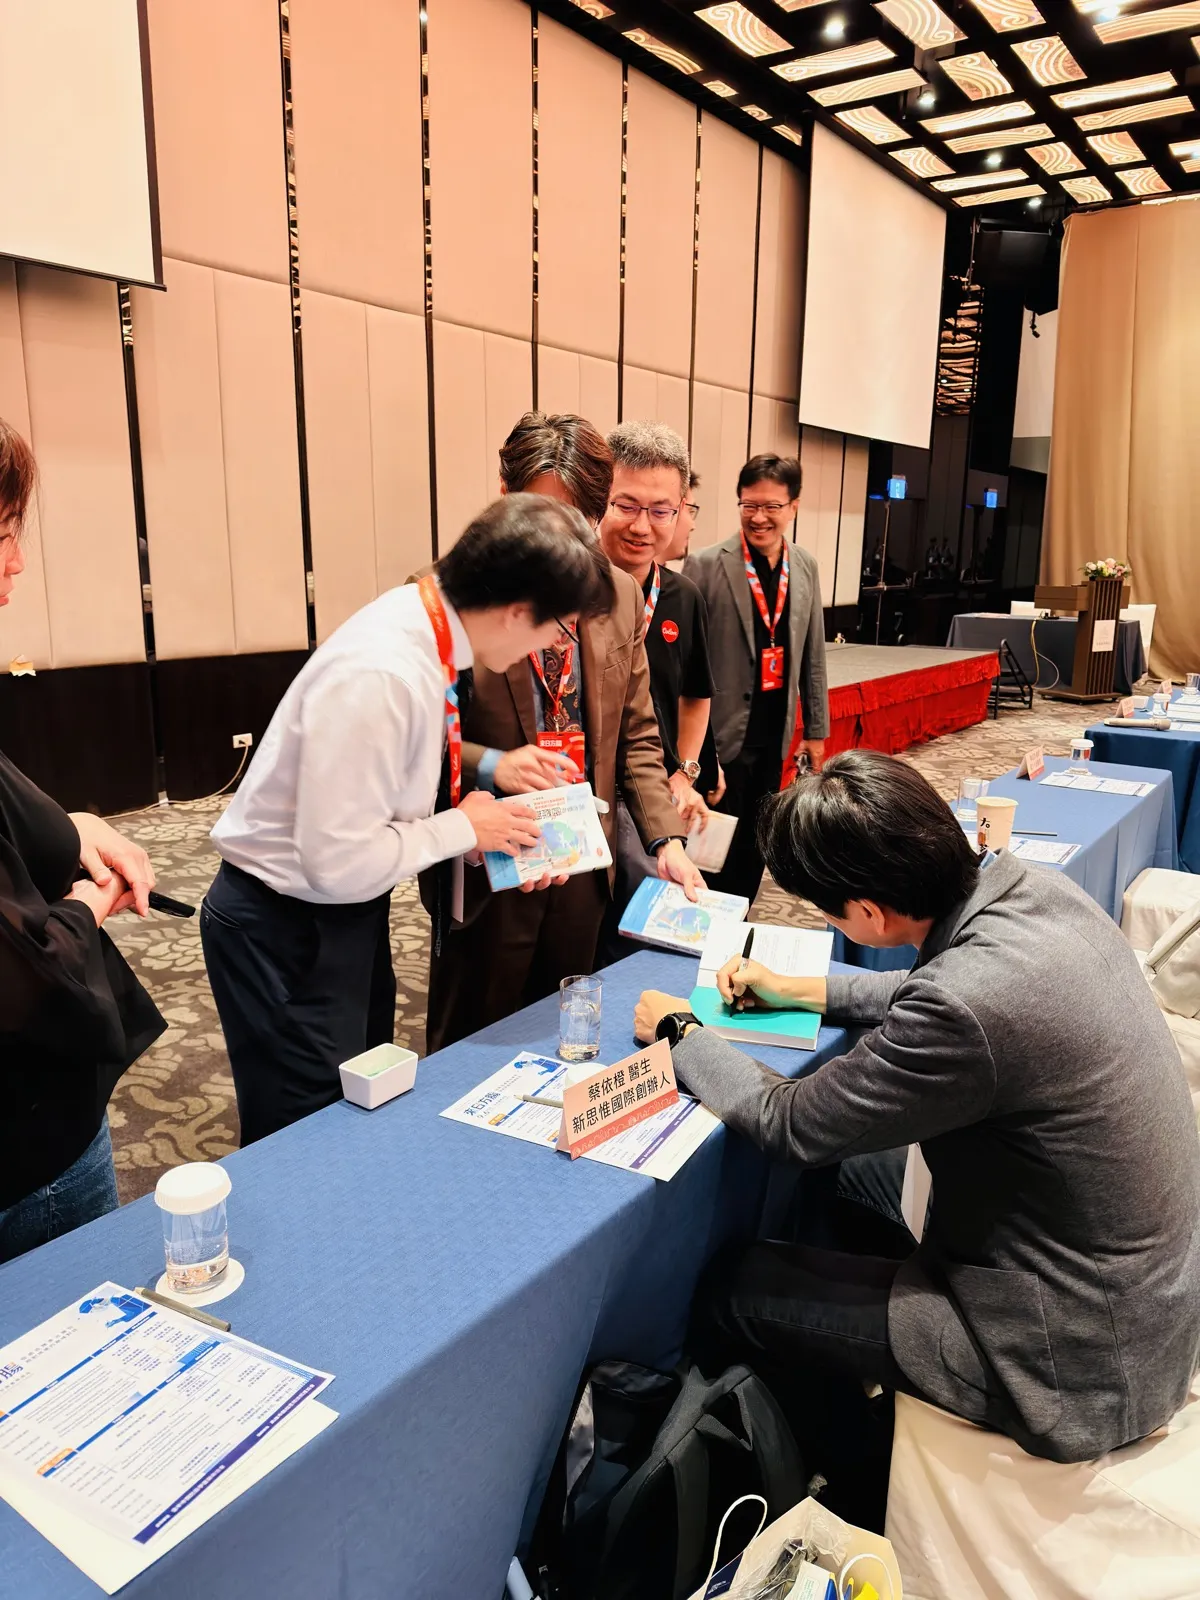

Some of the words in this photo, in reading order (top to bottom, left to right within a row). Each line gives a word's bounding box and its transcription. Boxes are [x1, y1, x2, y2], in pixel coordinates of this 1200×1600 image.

[572, 1071, 671, 1134] 新思惟國際創辦人
[588, 1069, 625, 1102] 蔡依橙
[628, 1057, 652, 1081] 醫生
